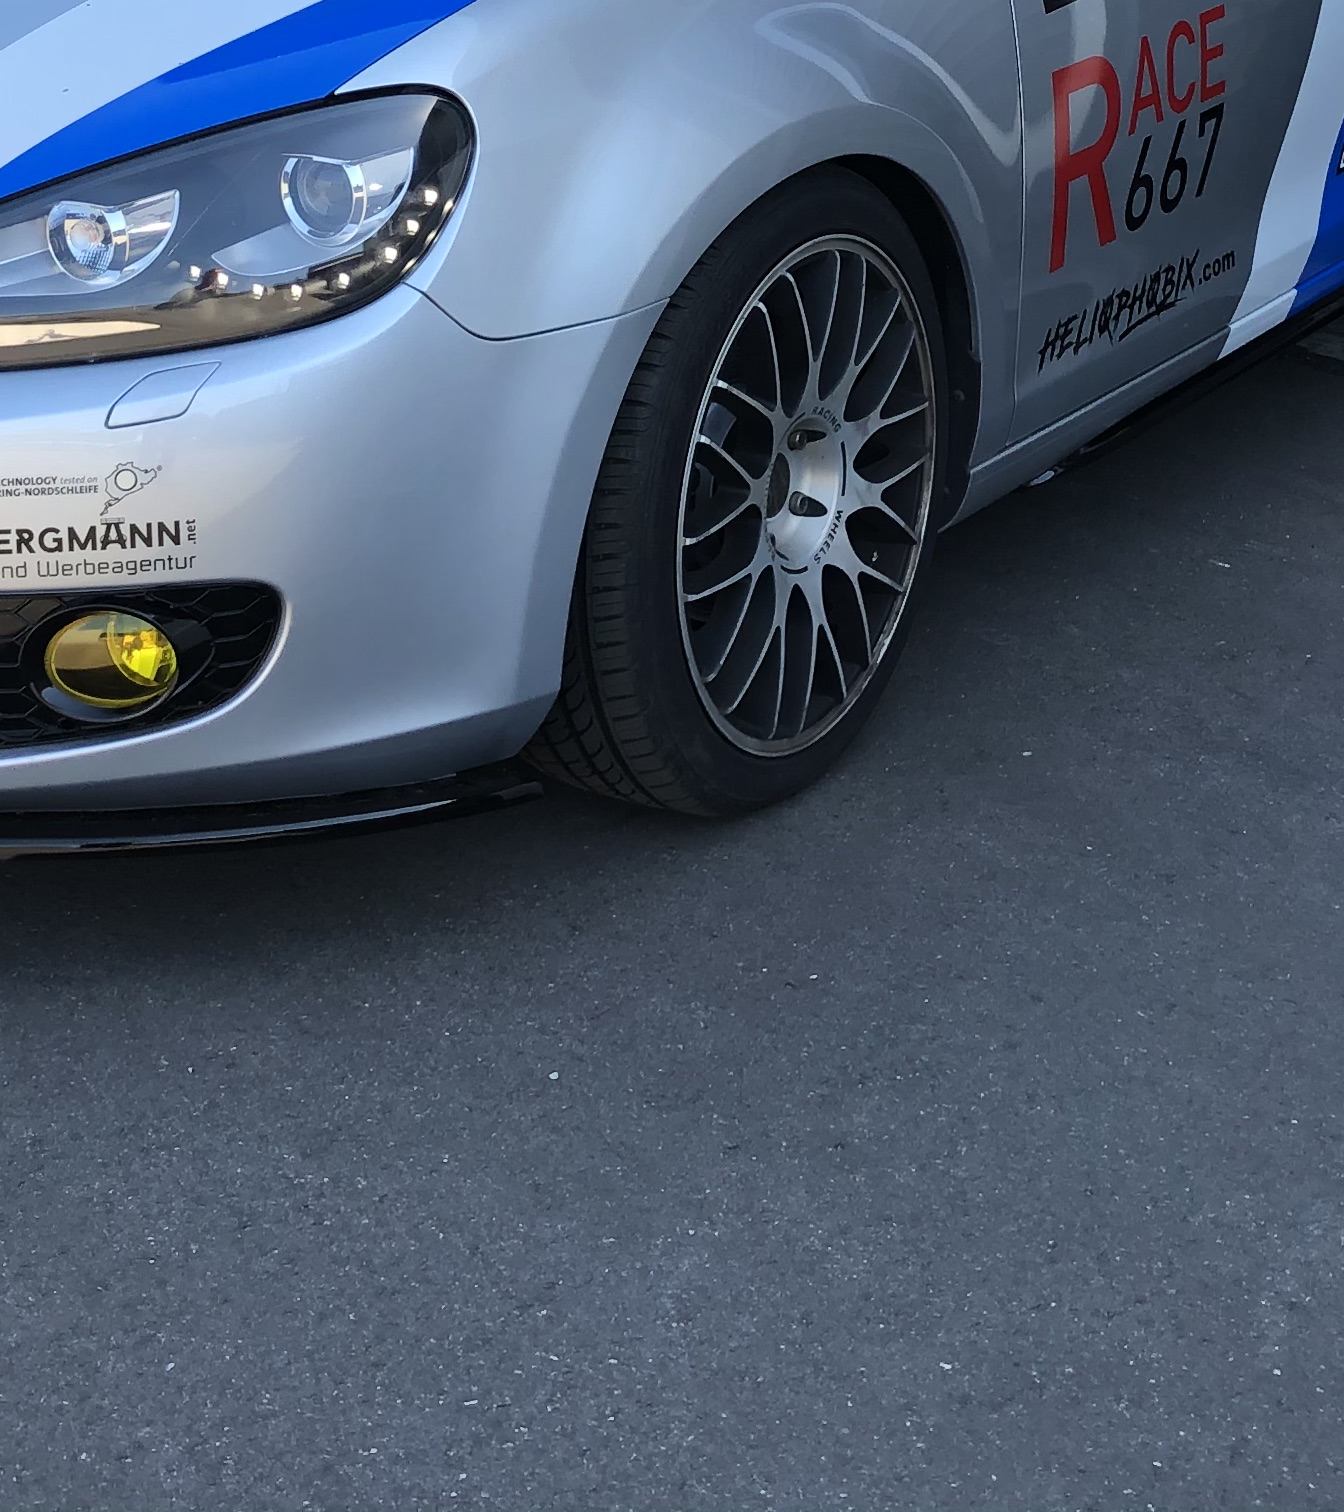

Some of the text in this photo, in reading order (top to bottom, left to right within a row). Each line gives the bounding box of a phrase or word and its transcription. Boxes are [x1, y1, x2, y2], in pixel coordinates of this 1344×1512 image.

[1124, 102, 1226, 232] 667
[810, 405, 842, 434] RACING
[59, 475, 86, 485] tested
[86, 476, 98, 484] on
[186, 518, 197, 545] .net
[812, 509, 844, 565] WHEELS
[36, 553, 197, 578] Werbeagentur
